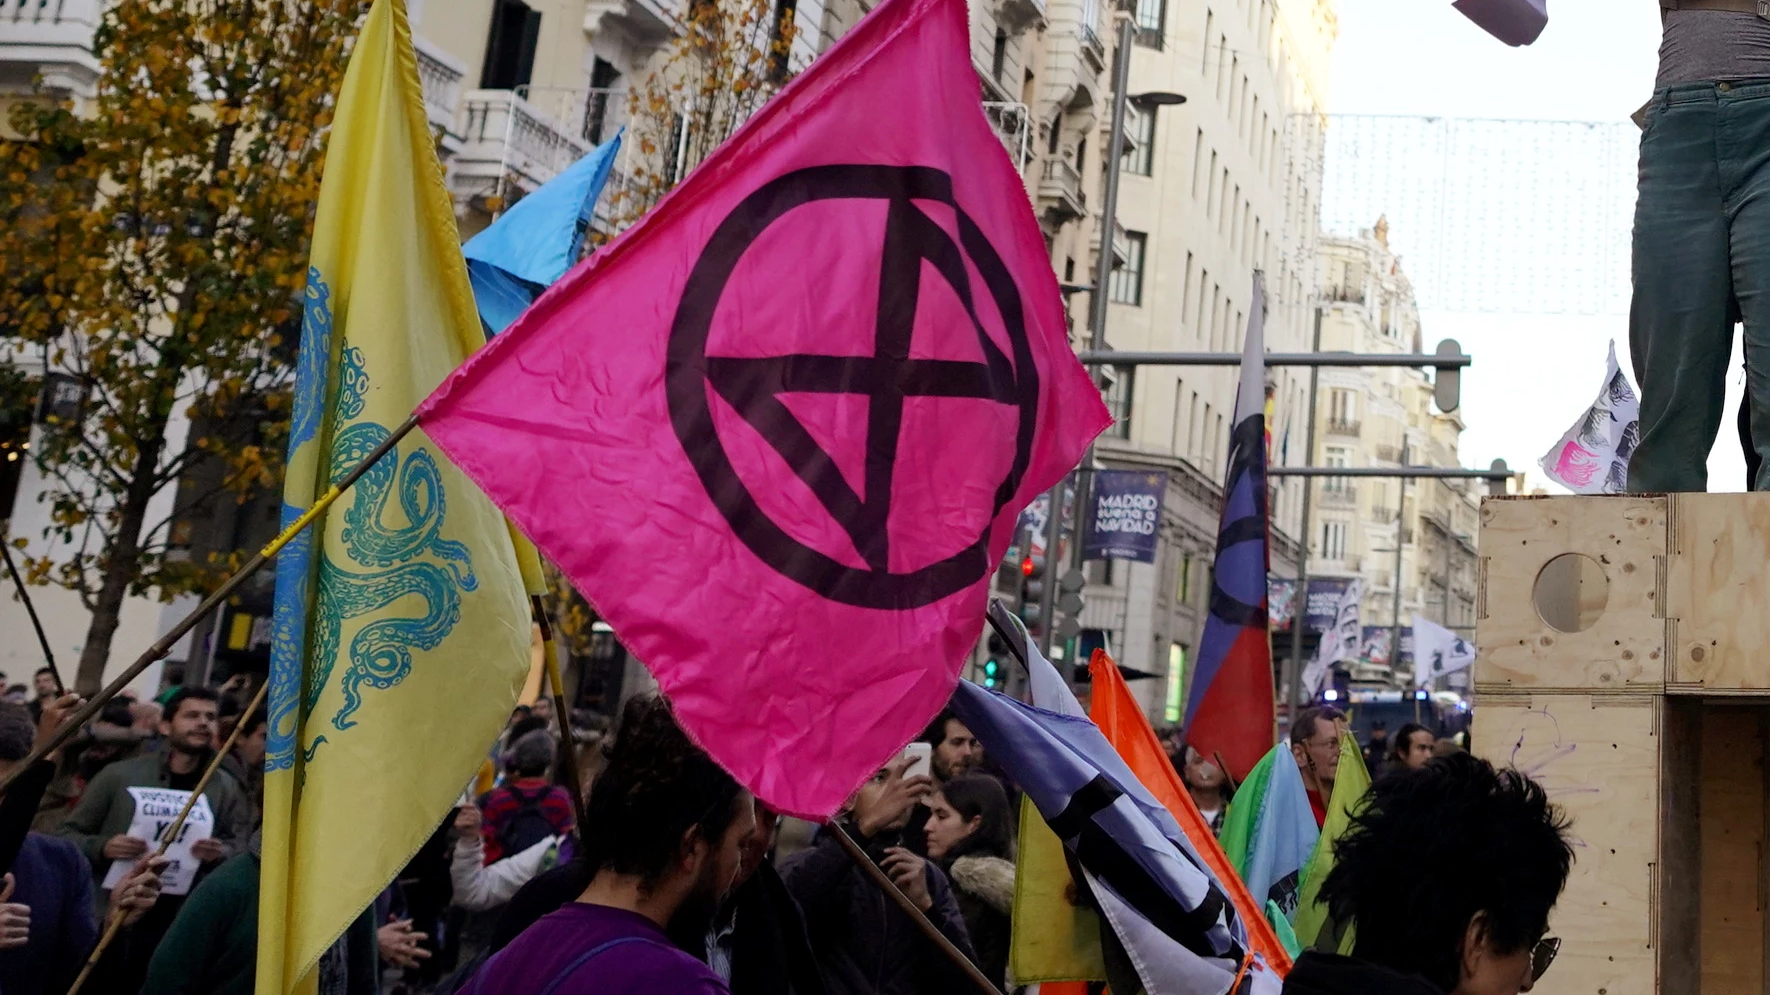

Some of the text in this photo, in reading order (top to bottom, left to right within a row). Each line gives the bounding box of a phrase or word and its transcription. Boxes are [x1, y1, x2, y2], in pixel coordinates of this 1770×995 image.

[1098, 494, 1157, 510] MADRID
[1097, 509, 1156, 521] suena a
[1095, 519, 1155, 535] NAVIDAD
[153, 820, 192, 843] Y!
